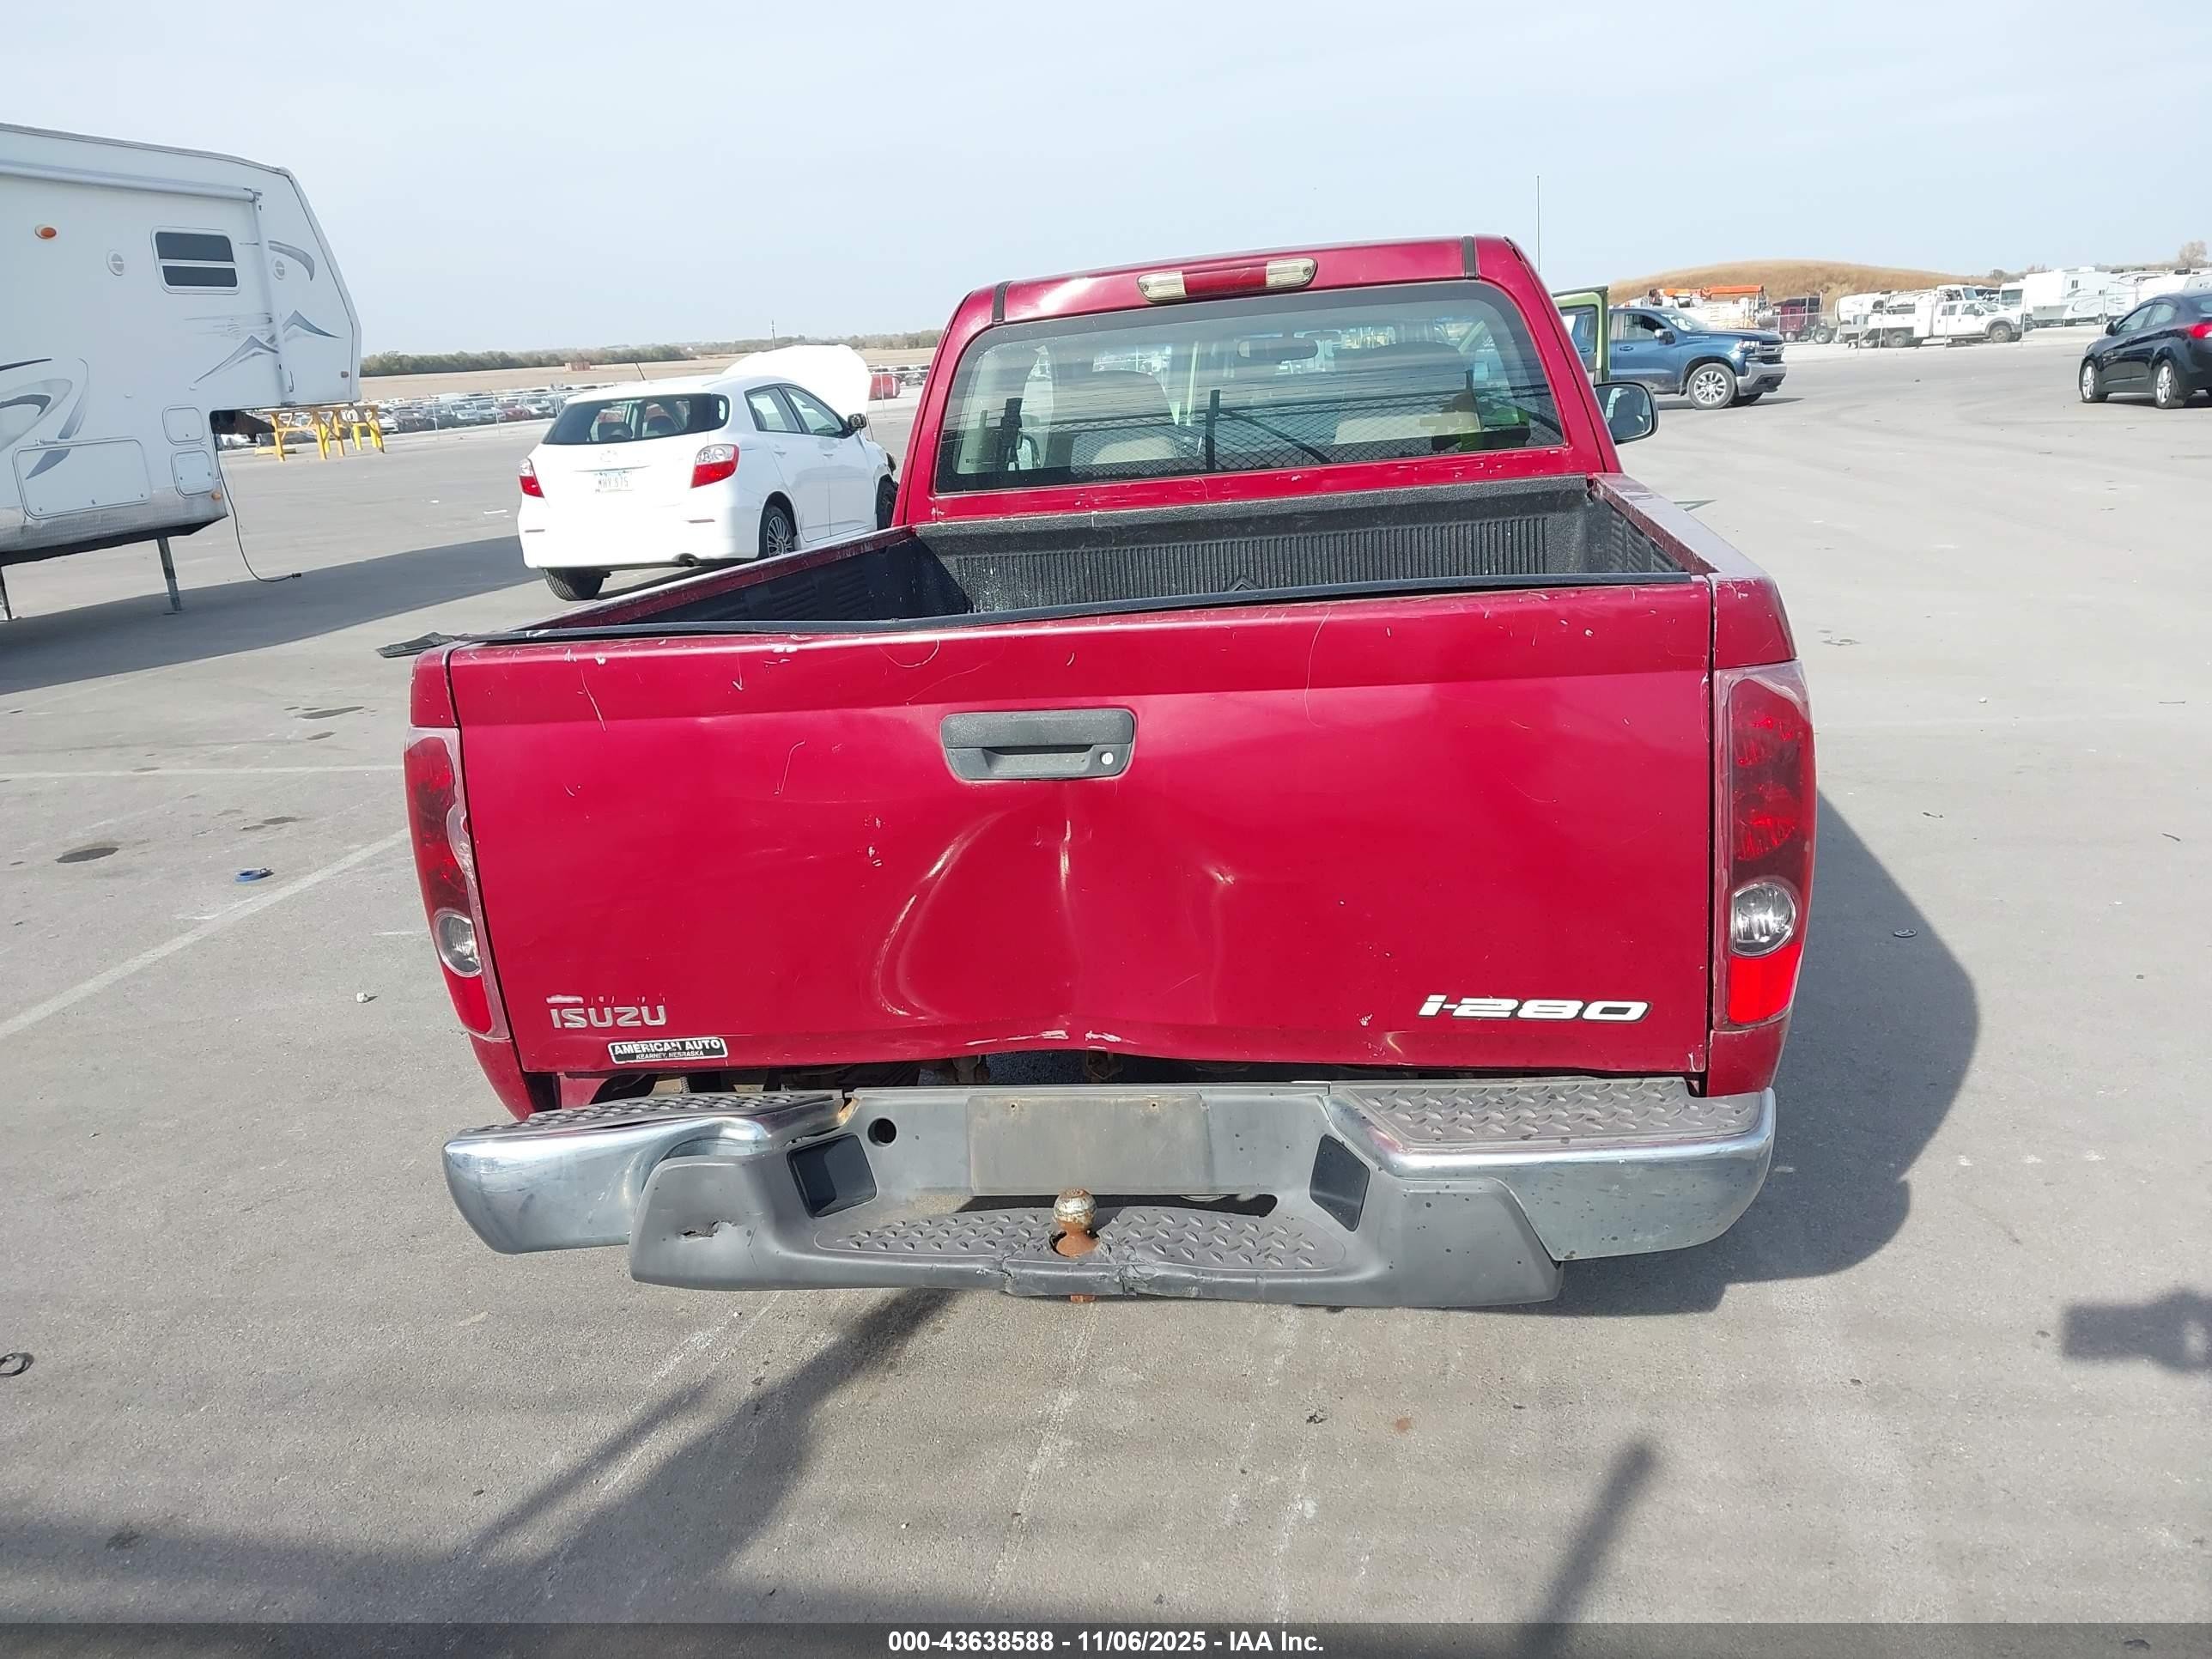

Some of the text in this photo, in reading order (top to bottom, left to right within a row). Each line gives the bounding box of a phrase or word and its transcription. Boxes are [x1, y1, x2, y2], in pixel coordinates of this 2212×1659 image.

[550, 1004, 667, 1029] ISUZU
[1418, 994, 1650, 1021] i-280
[614, 1038, 720, 1054] AMERICAN AUTO
